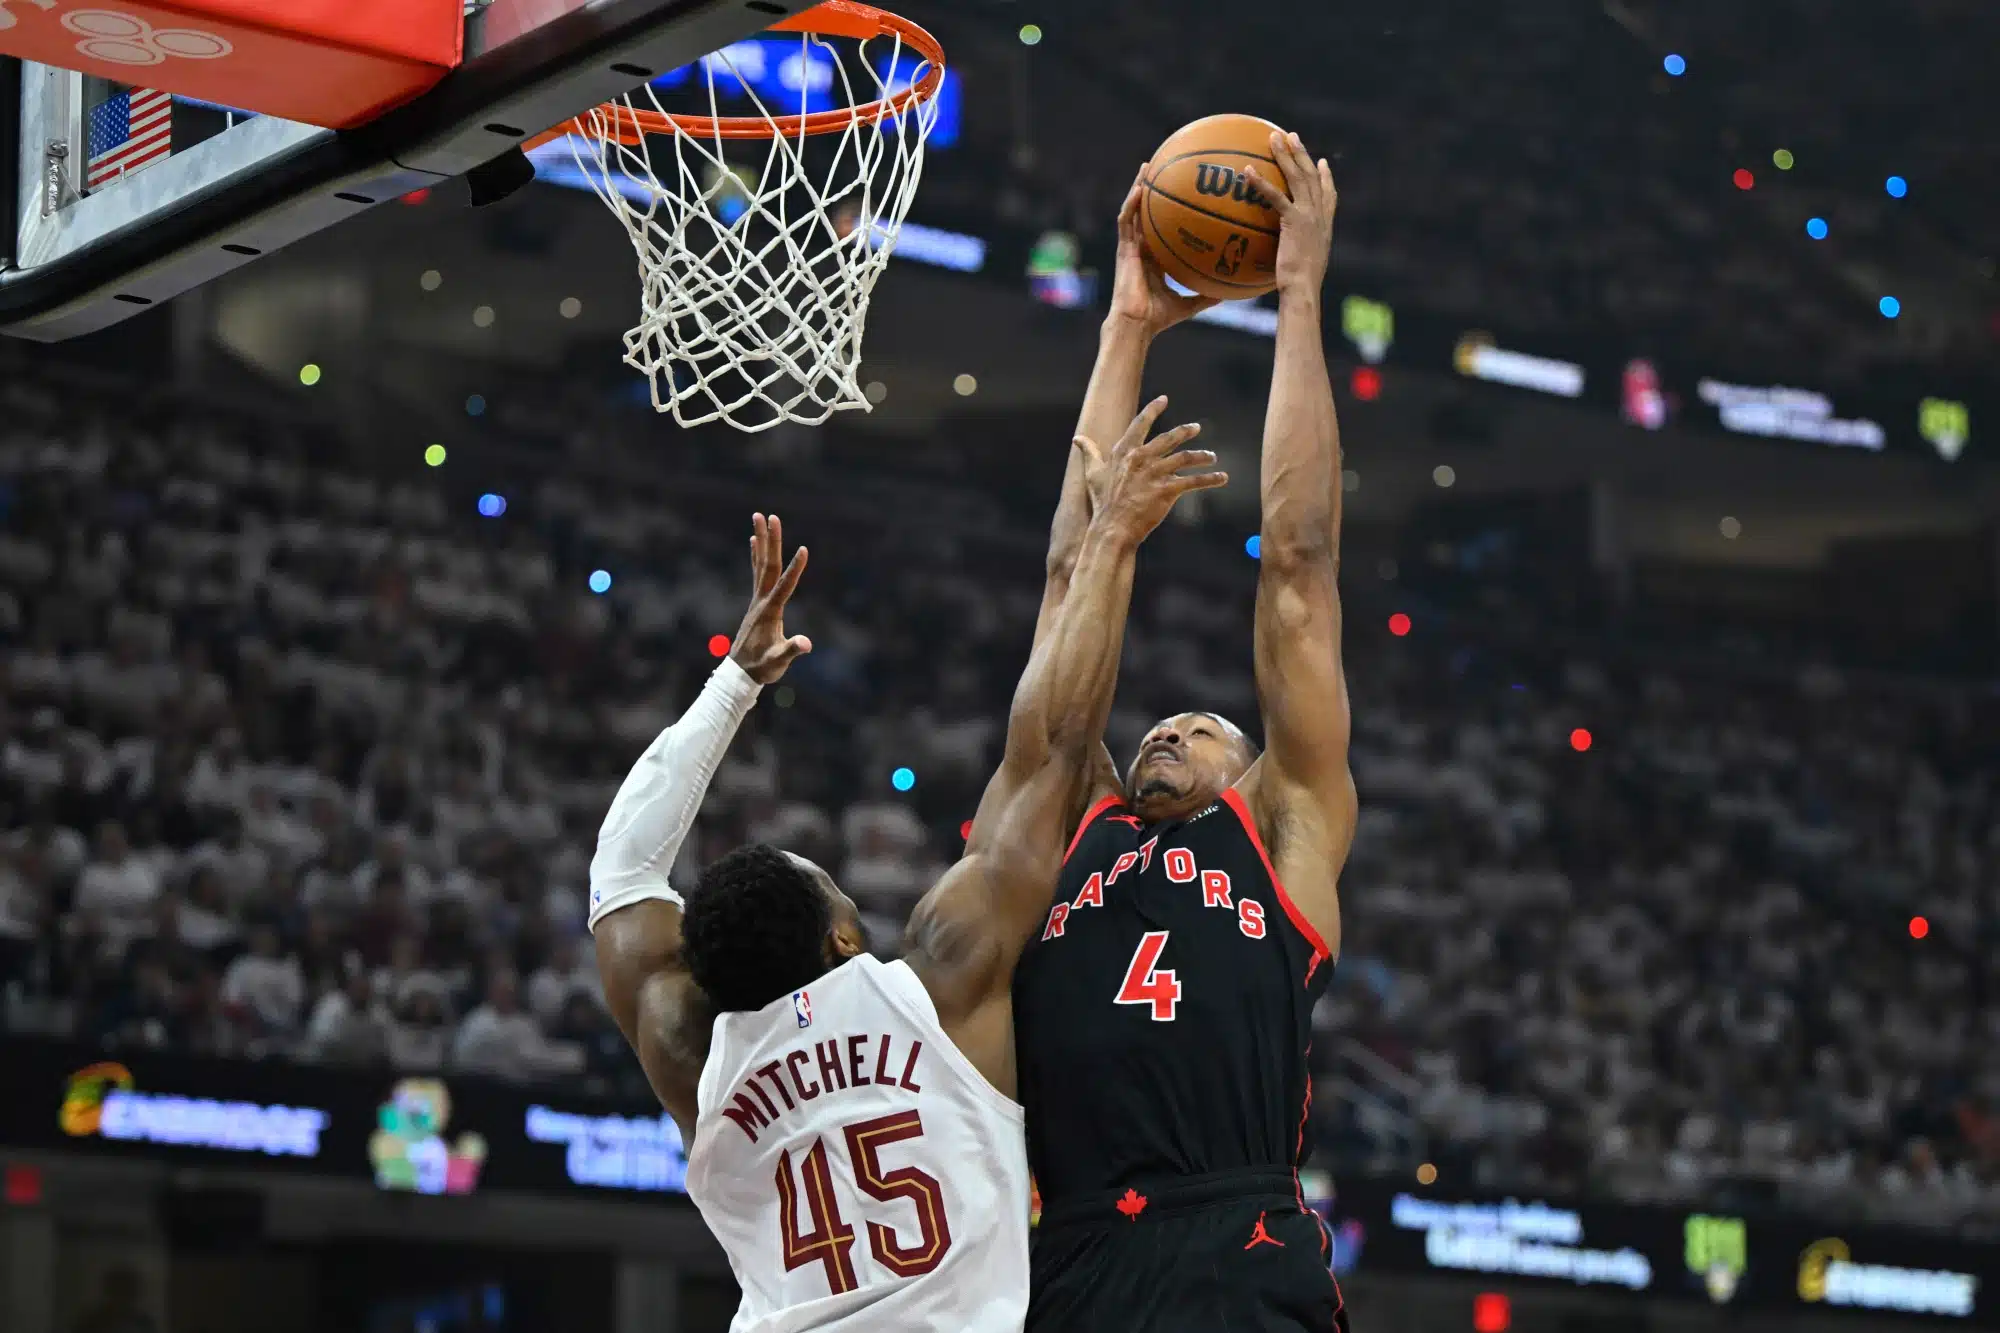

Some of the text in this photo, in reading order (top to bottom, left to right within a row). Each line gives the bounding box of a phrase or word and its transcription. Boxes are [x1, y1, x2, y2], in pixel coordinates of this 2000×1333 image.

[1196, 163, 1273, 209] Wil
[1041, 835, 1266, 942] RAPTORS
[1113, 930, 1182, 1023] 4
[722, 1034, 923, 1144] MITCHELL
[775, 1109, 953, 1296] 45
